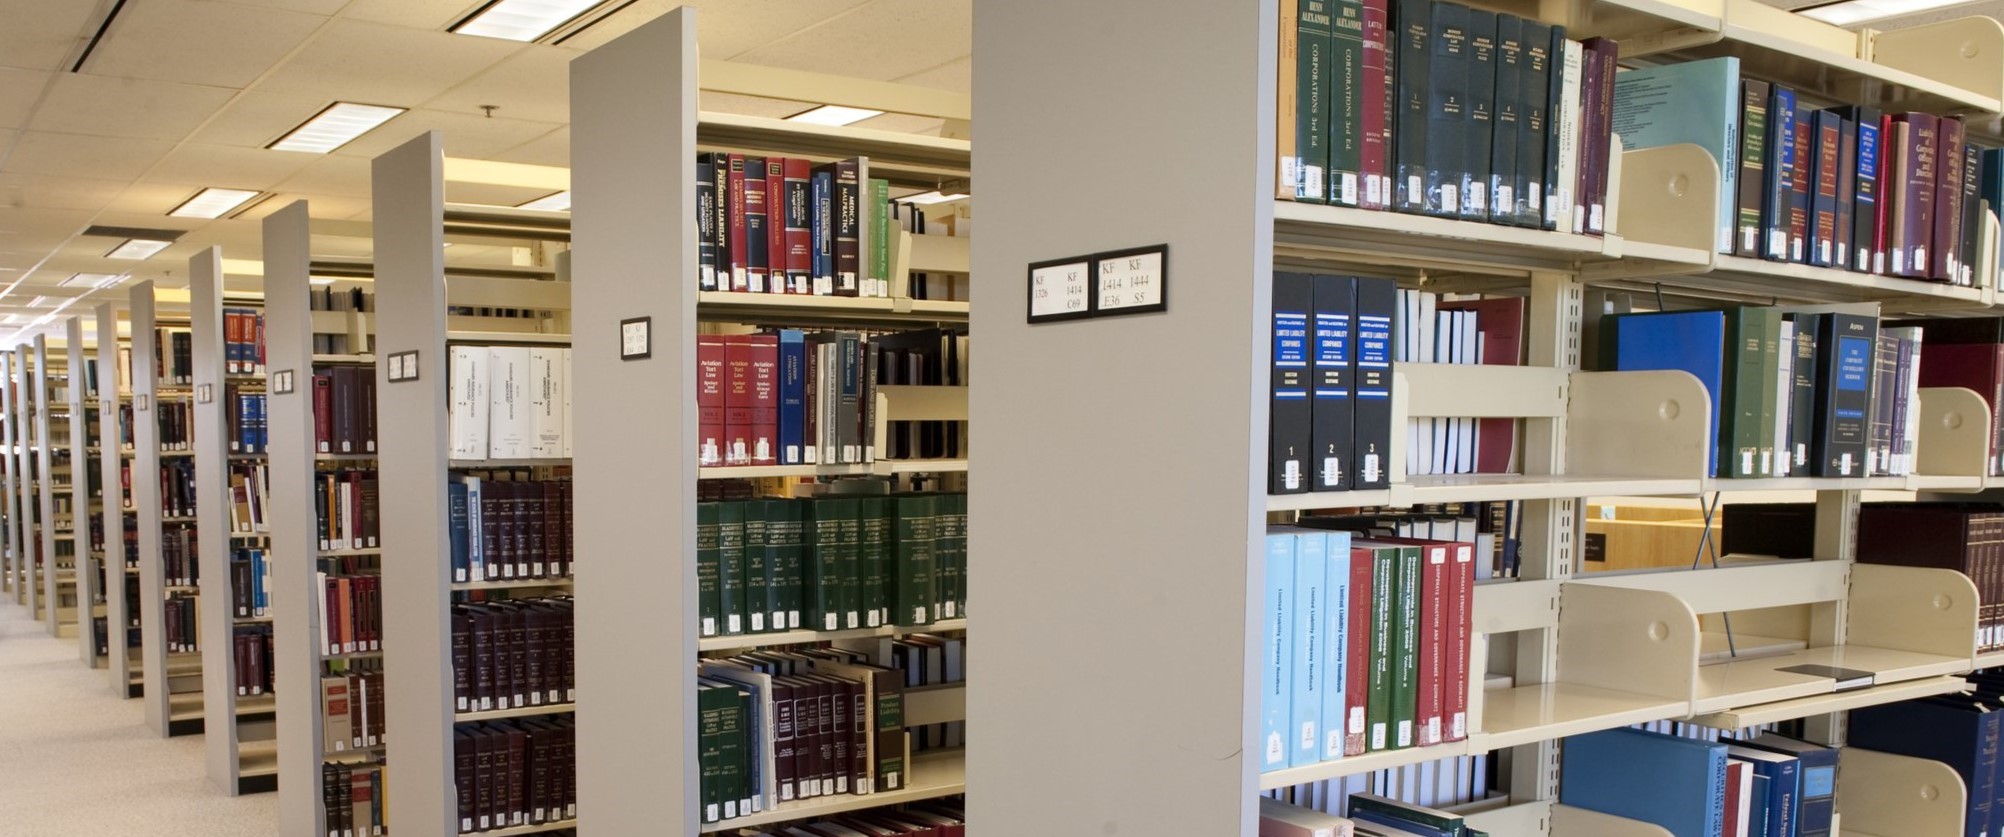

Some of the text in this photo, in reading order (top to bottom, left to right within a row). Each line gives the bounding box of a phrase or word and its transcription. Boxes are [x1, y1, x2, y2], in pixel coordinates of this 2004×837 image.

[1102, 262, 1115, 274] KF
[1129, 259, 1141, 271] KF
[1036, 276, 1044, 286] KF
[1068, 272, 1078, 282] KF
[1130, 275, 1149, 287] 1444
[1103, 279, 1122, 290] 1414
[1035, 289, 1048, 298] 1326
[1067, 286, 1082, 296] 1414
[1289, 446, 1293, 456] 1
[1329, 444, 1334, 454] 2
[1370, 443, 1374, 453] 3
[1714, 756, 1723, 810] CORPORATE
